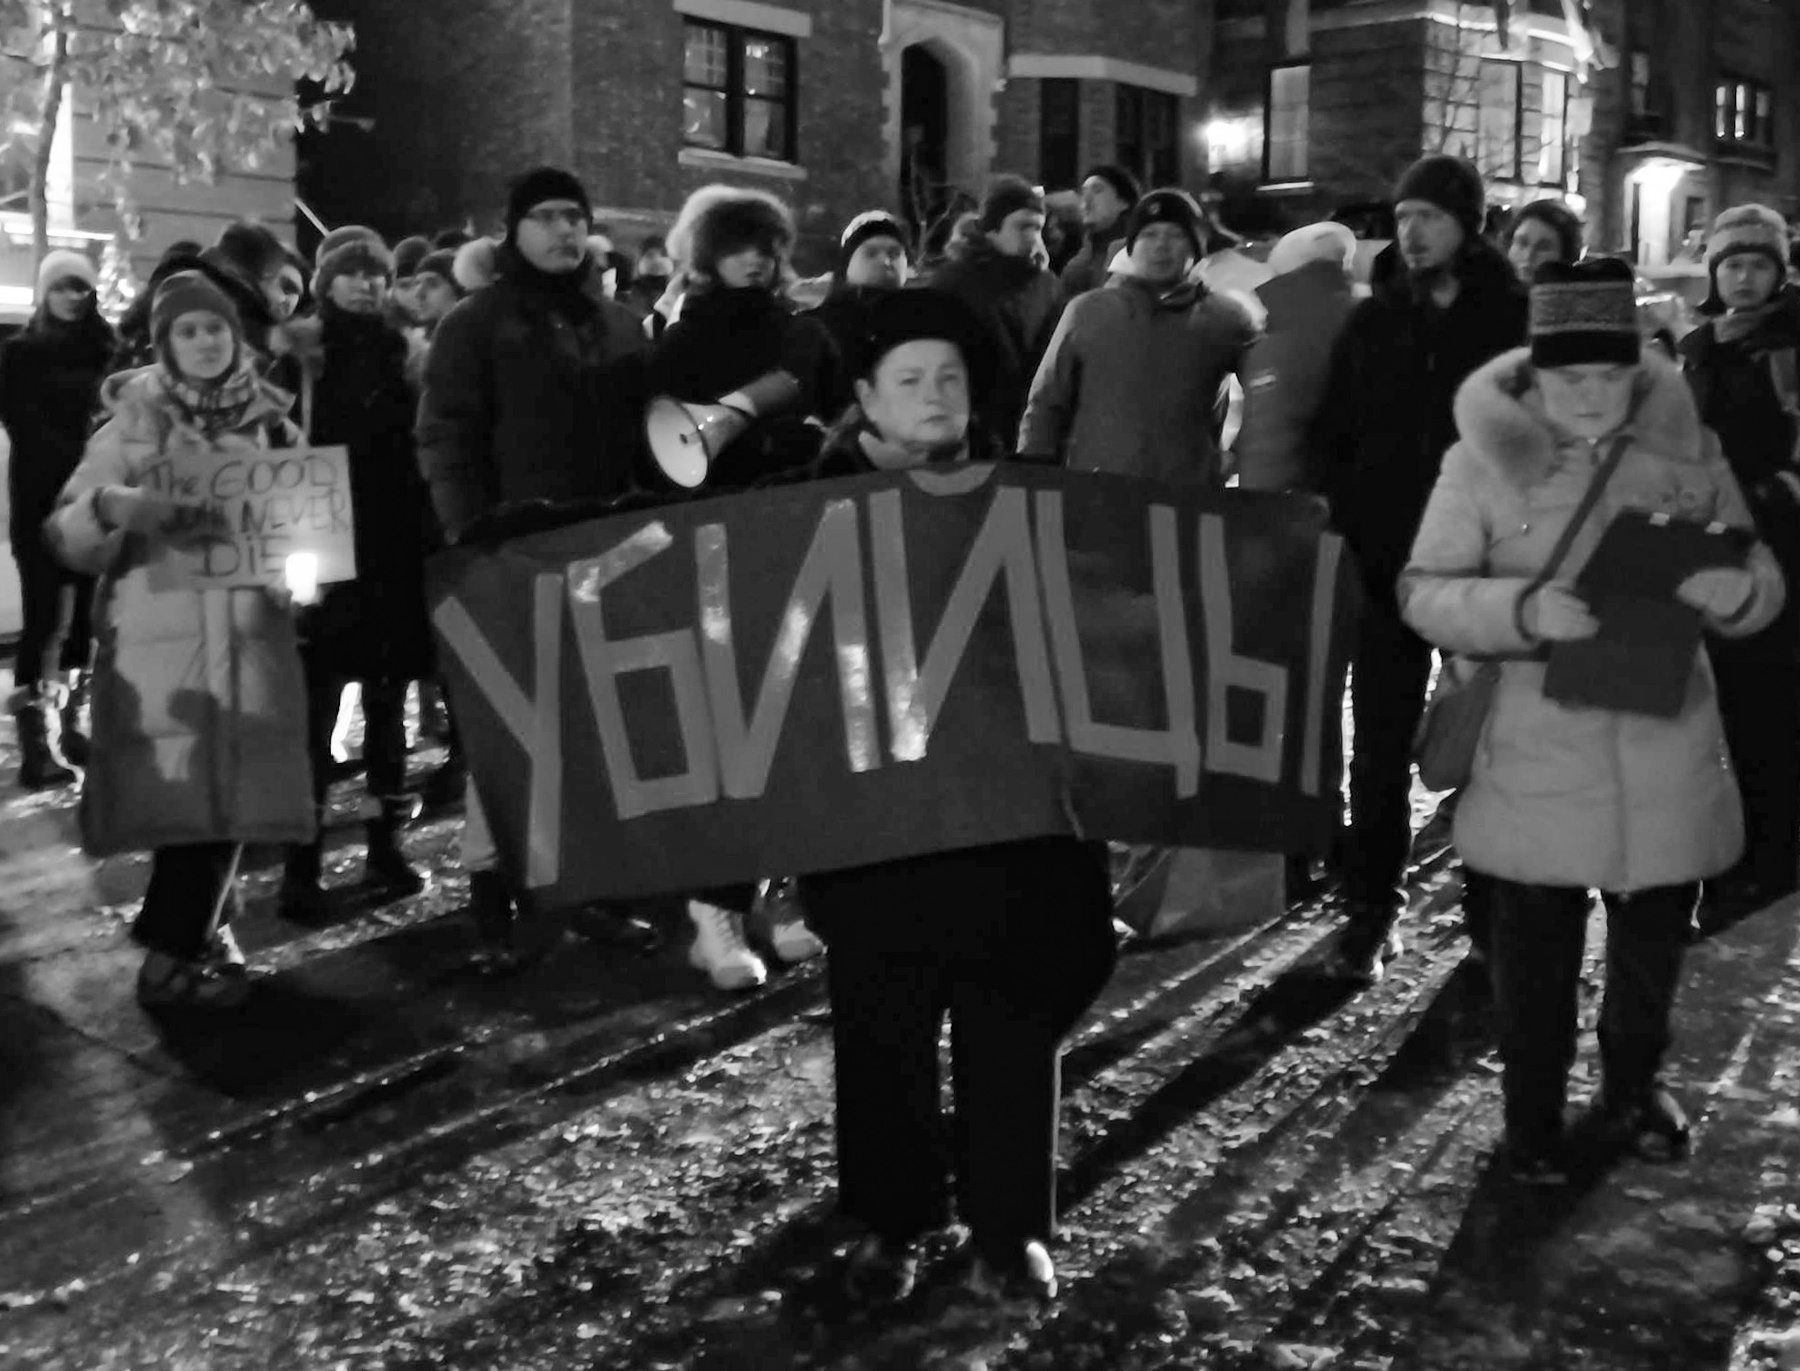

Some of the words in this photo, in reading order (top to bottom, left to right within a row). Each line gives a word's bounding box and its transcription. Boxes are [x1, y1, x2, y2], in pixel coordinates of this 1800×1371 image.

[209, 454, 337, 500] GOOD
[240, 488, 349, 534] NEVER
[433, 463, 1343, 887] УБИЙЦЫ
